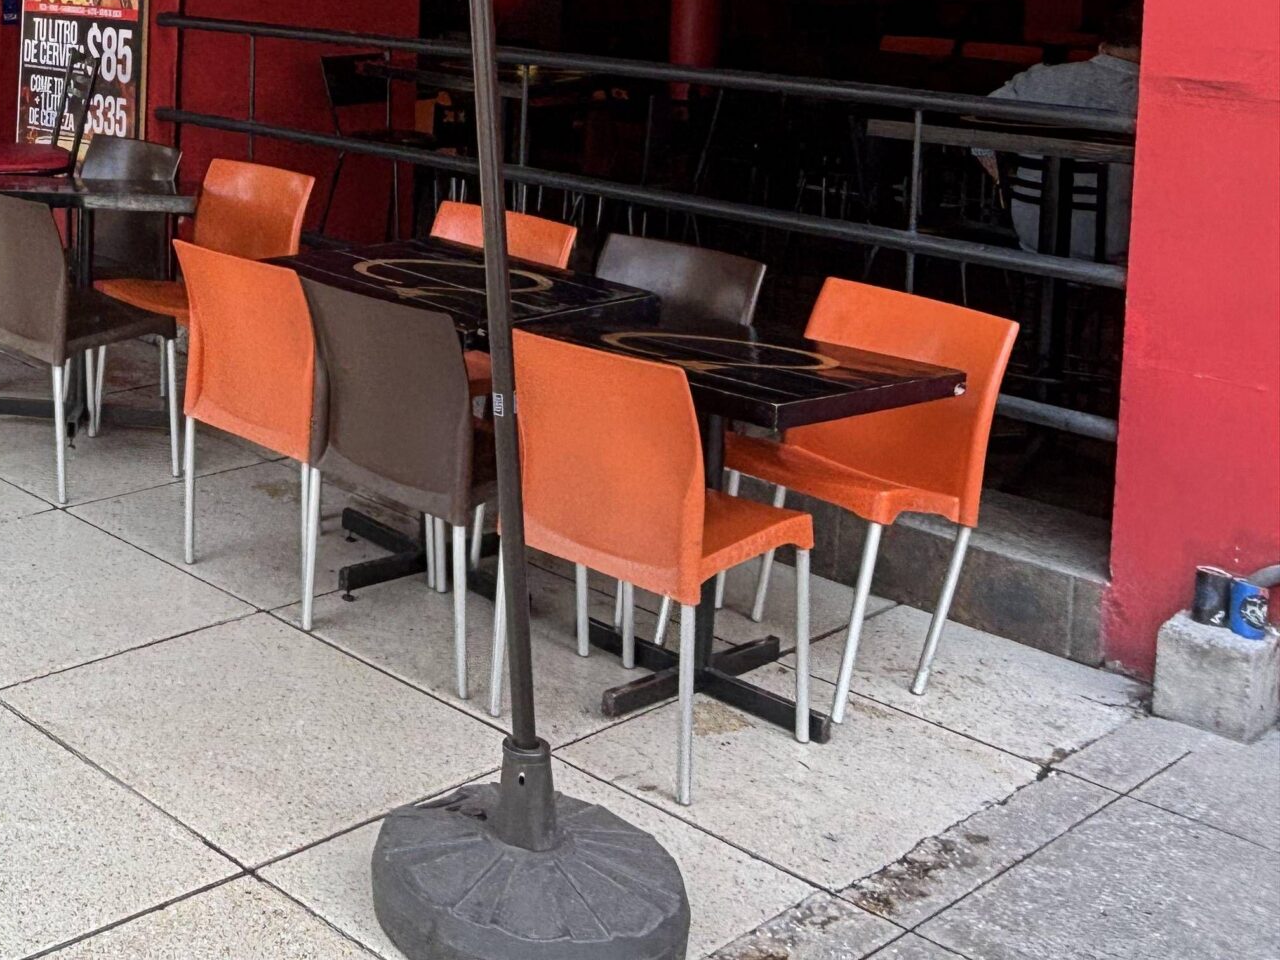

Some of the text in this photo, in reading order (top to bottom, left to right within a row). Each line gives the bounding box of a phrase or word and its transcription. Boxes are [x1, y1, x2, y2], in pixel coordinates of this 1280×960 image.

[33, 17, 78, 45] TU LITRO
[23, 39, 38, 63] DE
[30, 74, 74, 98] COME TO
[29, 106, 75, 132] DE CERZA
